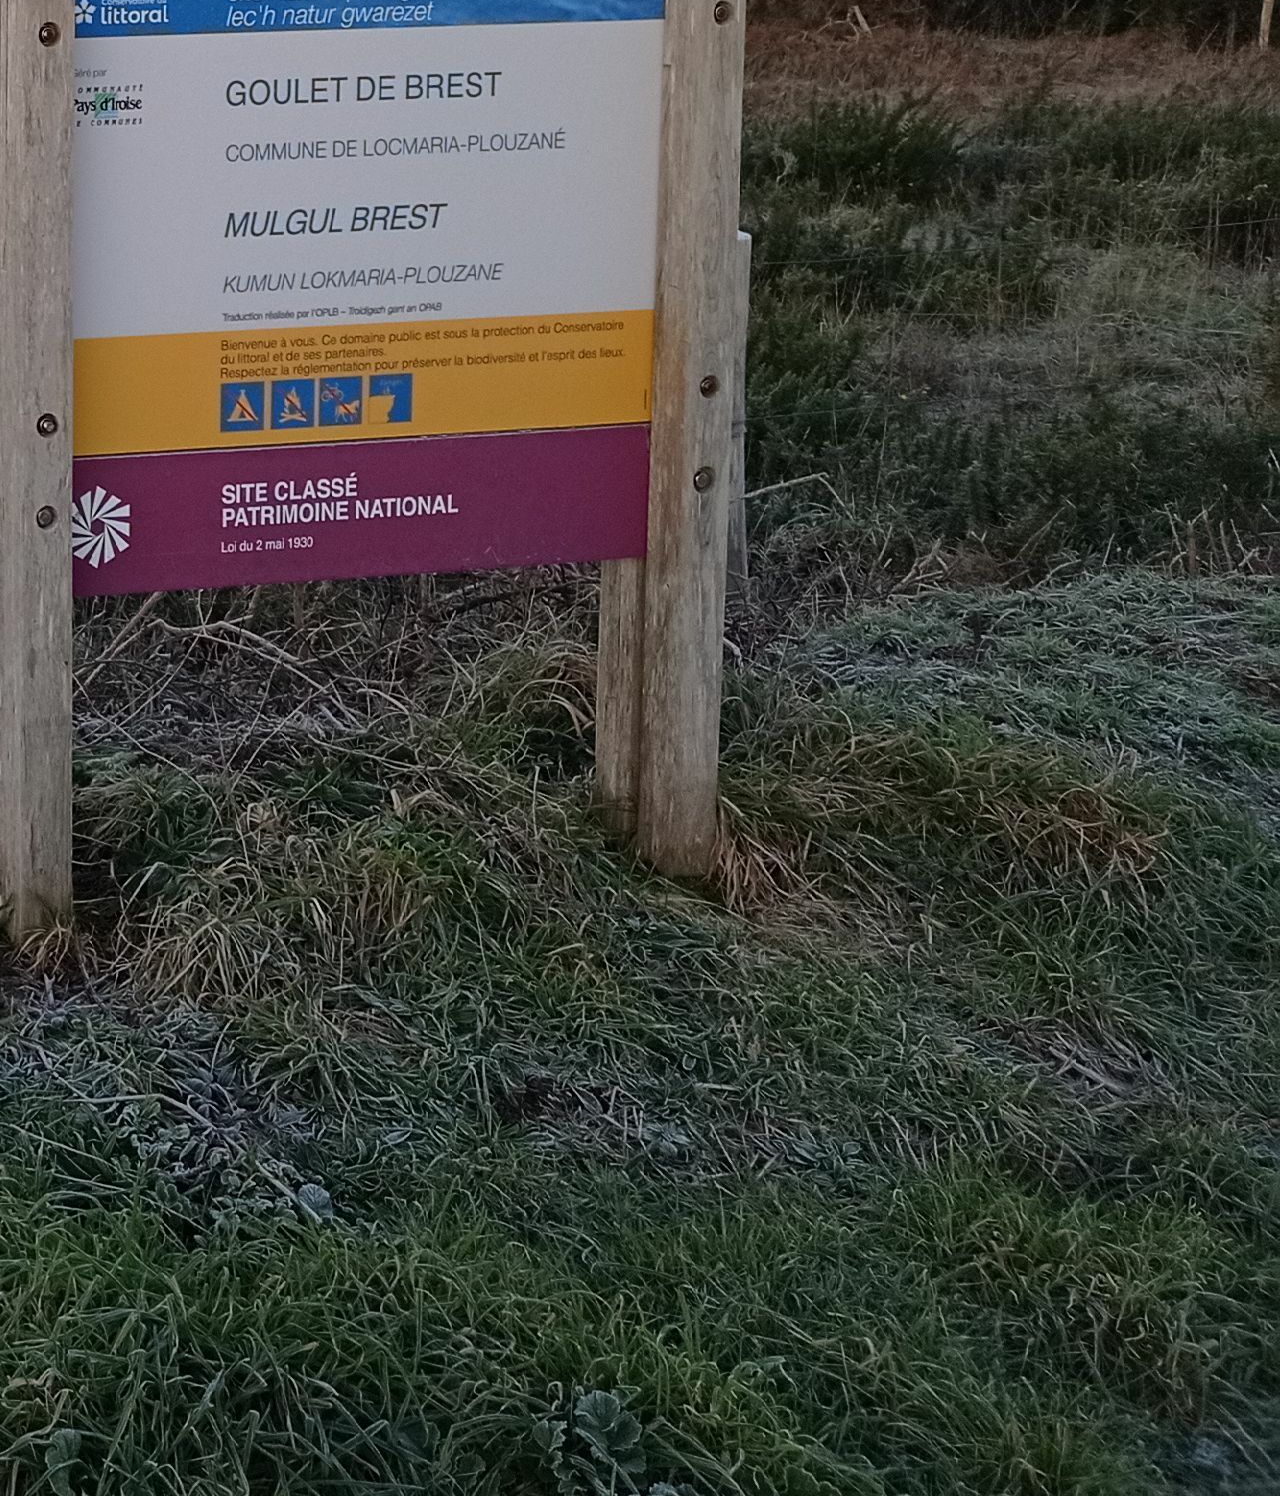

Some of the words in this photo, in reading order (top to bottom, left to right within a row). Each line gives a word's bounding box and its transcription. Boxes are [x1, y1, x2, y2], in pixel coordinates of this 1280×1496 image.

[101, 5, 169, 24] littoral
[226, 5, 276, 27] lec'h
[282, 7, 336, 26] natur
[341, 1, 433, 28] gwarezet
[100, 96, 142, 111] d'Iroise
[226, 77, 348, 106] GOULET
[357, 76, 395, 101] DE
[406, 72, 502, 99] BREST
[226, 140, 327, 162] COMMUNE
[333, 139, 357, 158] DE
[363, 128, 565, 157] LOCMARIA-PLOUZANÉ
[224, 208, 343, 238] MULGUL
[351, 203, 448, 232] BREST
[223, 272, 295, 294] KUMUN
[300, 263, 504, 290] LOKMARIA-PLOUZANE
[222, 312, 263, 322] Traduction
[221, 339, 277, 351] Bienvenue
[280, 337, 287, 348] à
[290, 338, 318, 348] vous.
[322, 334, 336, 346] Ce
[340, 333, 386, 345] domaine
[389, 330, 422, 345] public
[425, 330, 440, 341] est
[443, 330, 468, 340] sous
[471, 328, 480, 338] la
[483, 324, 534, 339] protection
[538, 324, 551, 334] du
[554, 320, 624, 334] Conservatoire
[220, 366, 278, 380] Respectez
[281, 365, 290, 375] la
[293, 360, 371, 377] réglementation
[375, 361, 398, 372] pour
[402, 356, 452, 371] préserver
[454, 355, 463, 366] la
[467, 351, 525, 365] biodiversité
[528, 352, 539, 362] et
[541, 348, 575, 363] l'esprit
[578, 348, 596, 359] des
[221, 354, 235, 365] du
[238, 351, 270, 364] littoral
[273, 351, 283, 362] et
[285, 350, 300, 361] de
[303, 350, 322, 360] ses
[325, 347, 387, 362] partenaires.
[222, 482, 268, 504] SITE
[274, 472, 357, 501] CLASSÉ
[222, 501, 349, 528] PATRIMOINE
[355, 494, 459, 519] NATIONAL
[221, 541, 237, 553] Loi
[239, 539, 253, 552] du
[256, 540, 263, 551] 2
[265, 537, 285, 550] mai
[288, 536, 313, 549] 1930
